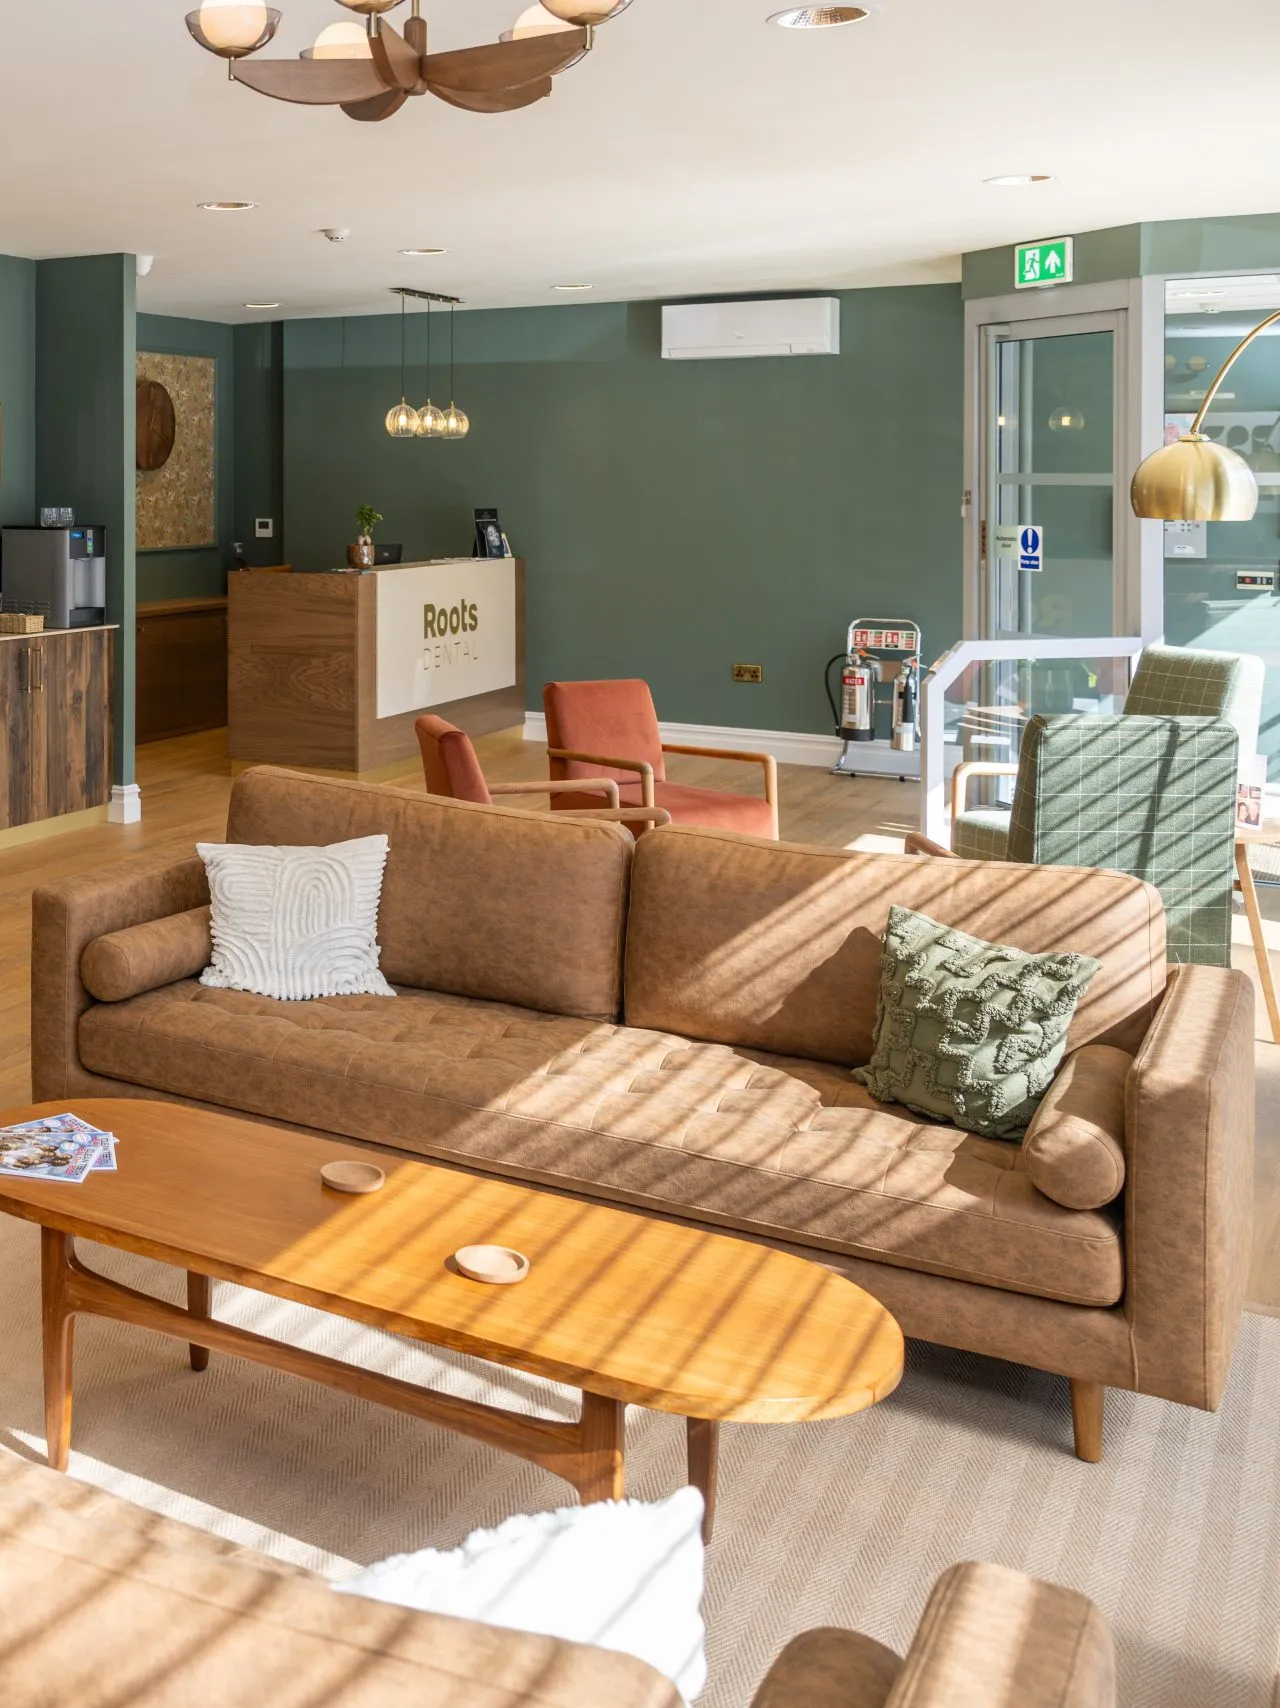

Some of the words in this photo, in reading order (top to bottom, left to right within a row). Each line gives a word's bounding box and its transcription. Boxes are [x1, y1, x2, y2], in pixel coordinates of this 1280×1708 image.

[423, 598, 478, 639] Roots
[423, 638, 480, 671] DENTAL
[844, 677, 862, 685] WATER
